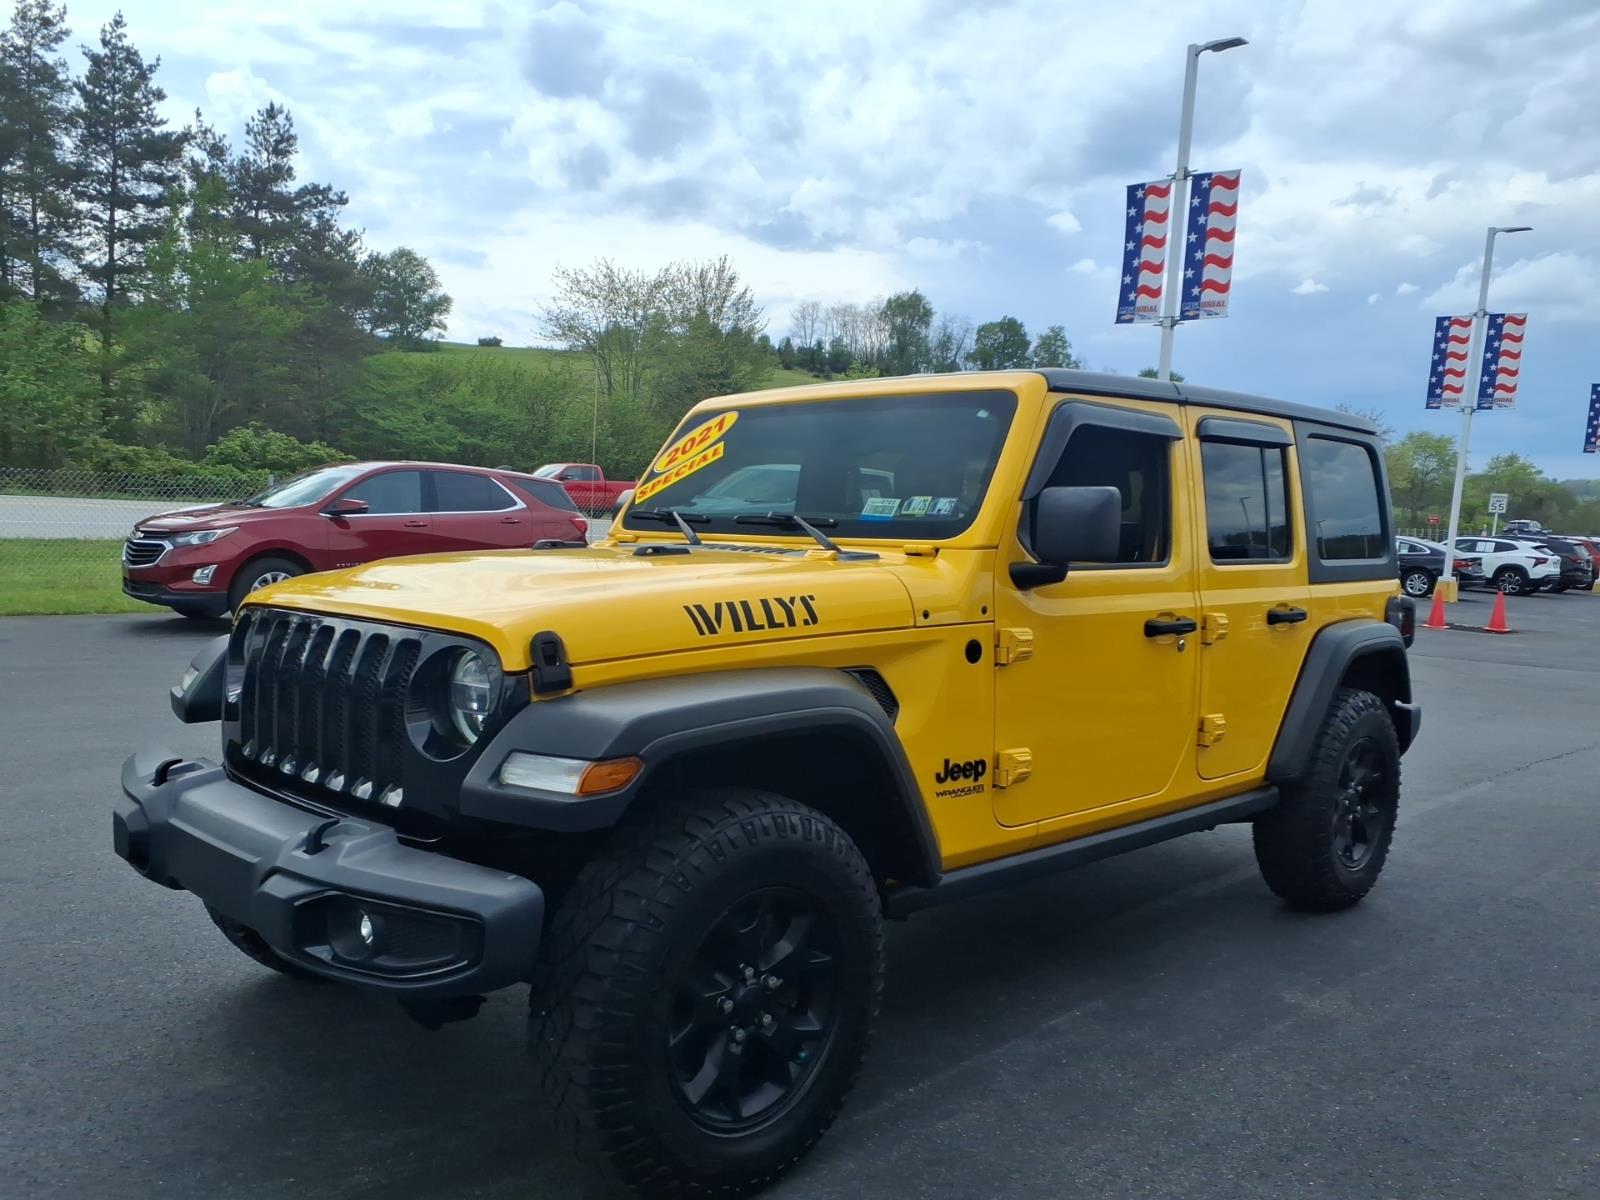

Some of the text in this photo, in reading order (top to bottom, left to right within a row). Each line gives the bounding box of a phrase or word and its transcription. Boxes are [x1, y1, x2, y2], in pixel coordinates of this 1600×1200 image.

[664, 415, 727, 469] 2021
[637, 446, 721, 500] SPECIAL
[1490, 503, 1505, 511] 55
[682, 594, 819, 636] WILLYS
[935, 758, 987, 784] Jeep
[935, 784, 985, 798] WRANGLER
